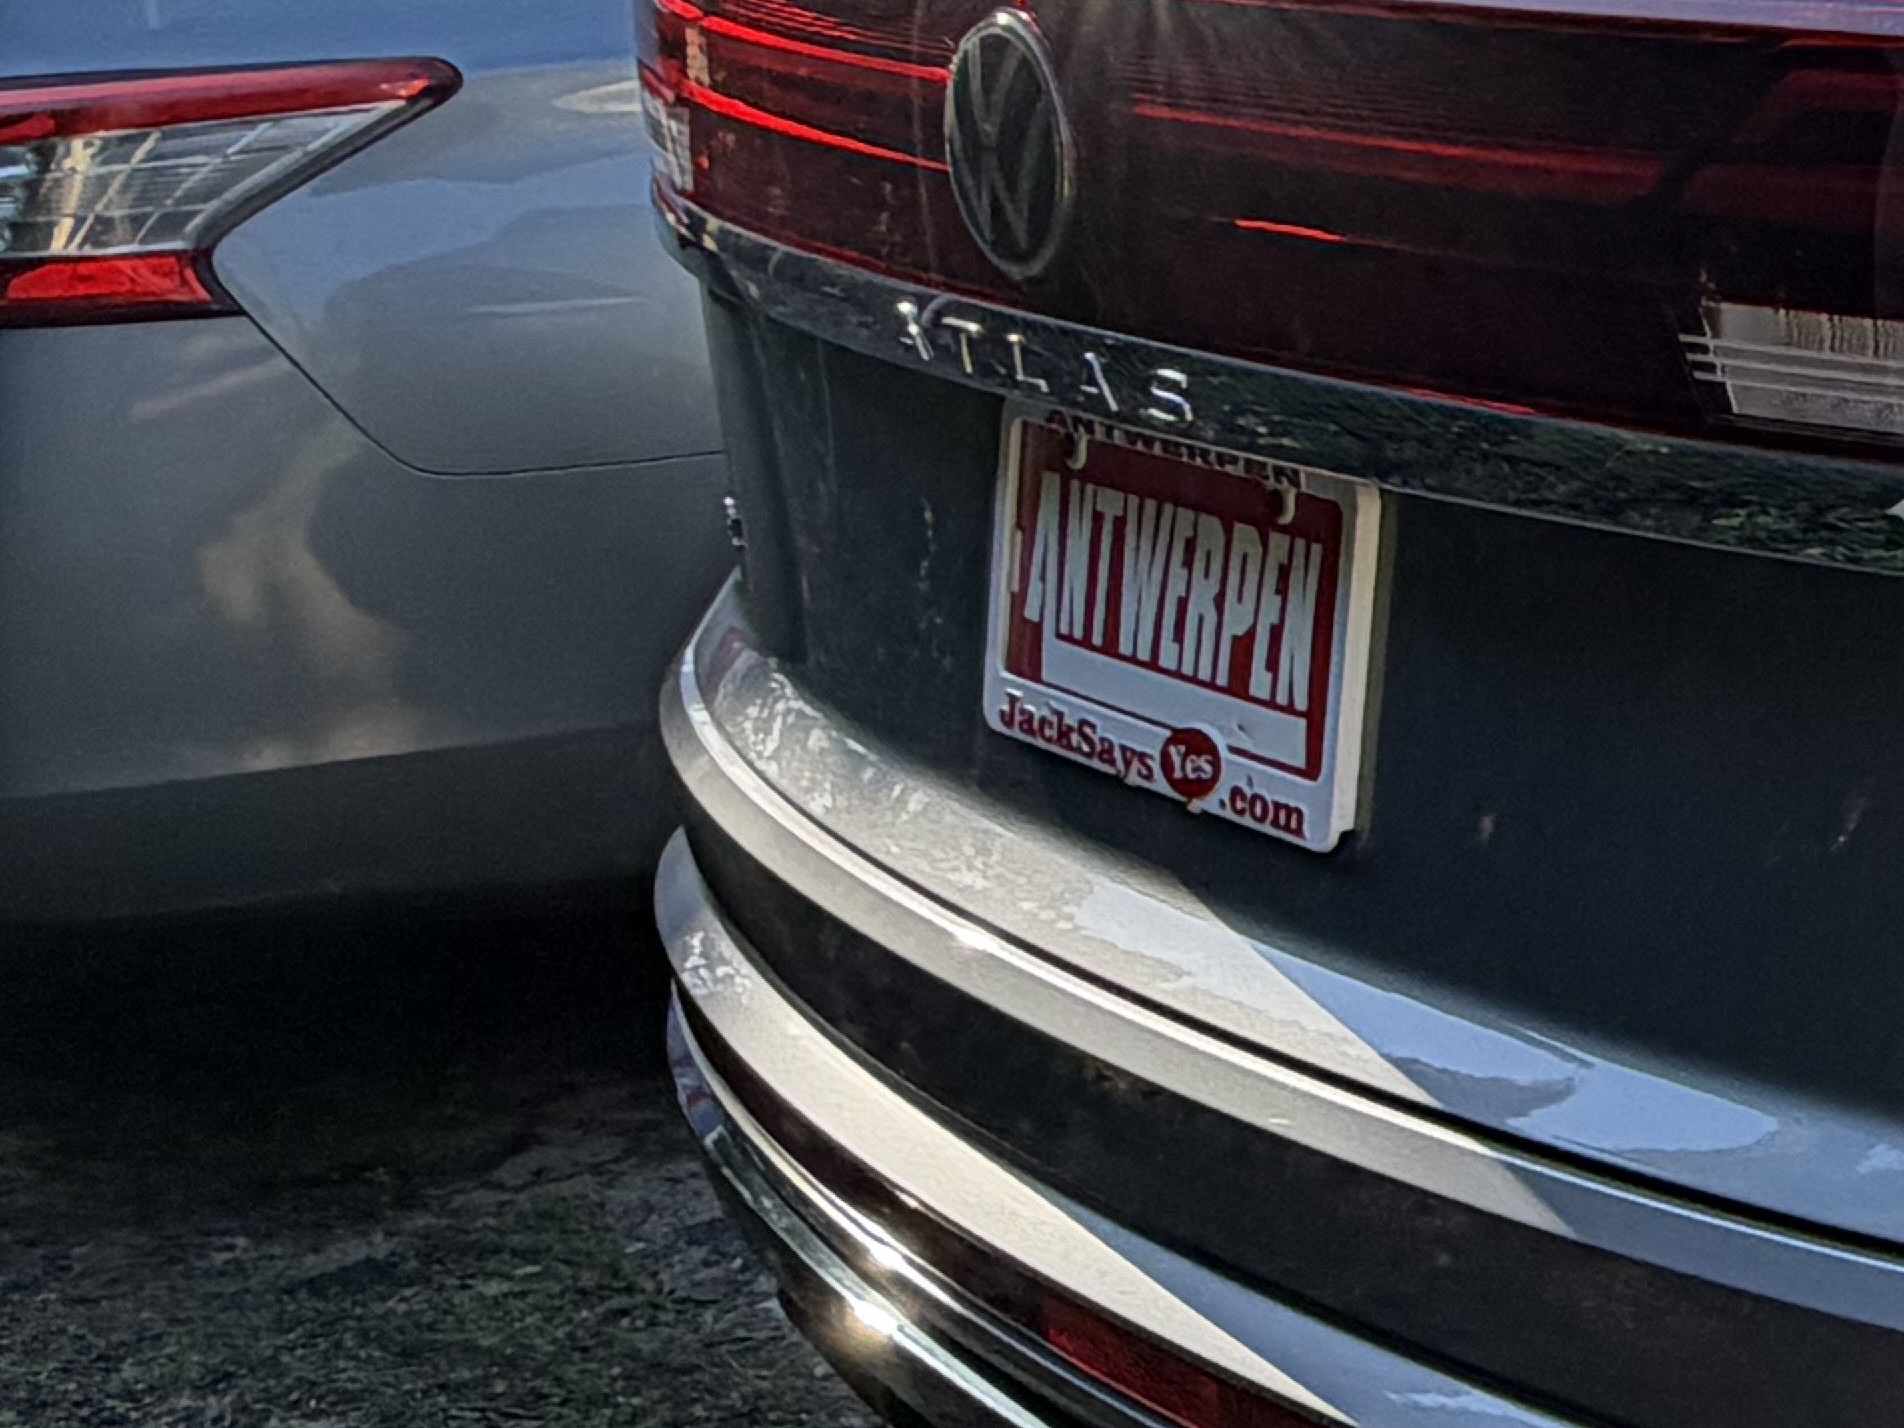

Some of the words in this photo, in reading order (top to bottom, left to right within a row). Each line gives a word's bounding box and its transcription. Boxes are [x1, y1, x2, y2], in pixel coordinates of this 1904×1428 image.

[895, 298, 1193, 423] ATLAS
[1024, 472, 1323, 711] ANTWERPEN
[1000, 688, 1155, 783] JackSays
[1168, 744, 1214, 780] Yes
[1219, 783, 1306, 841] .com
